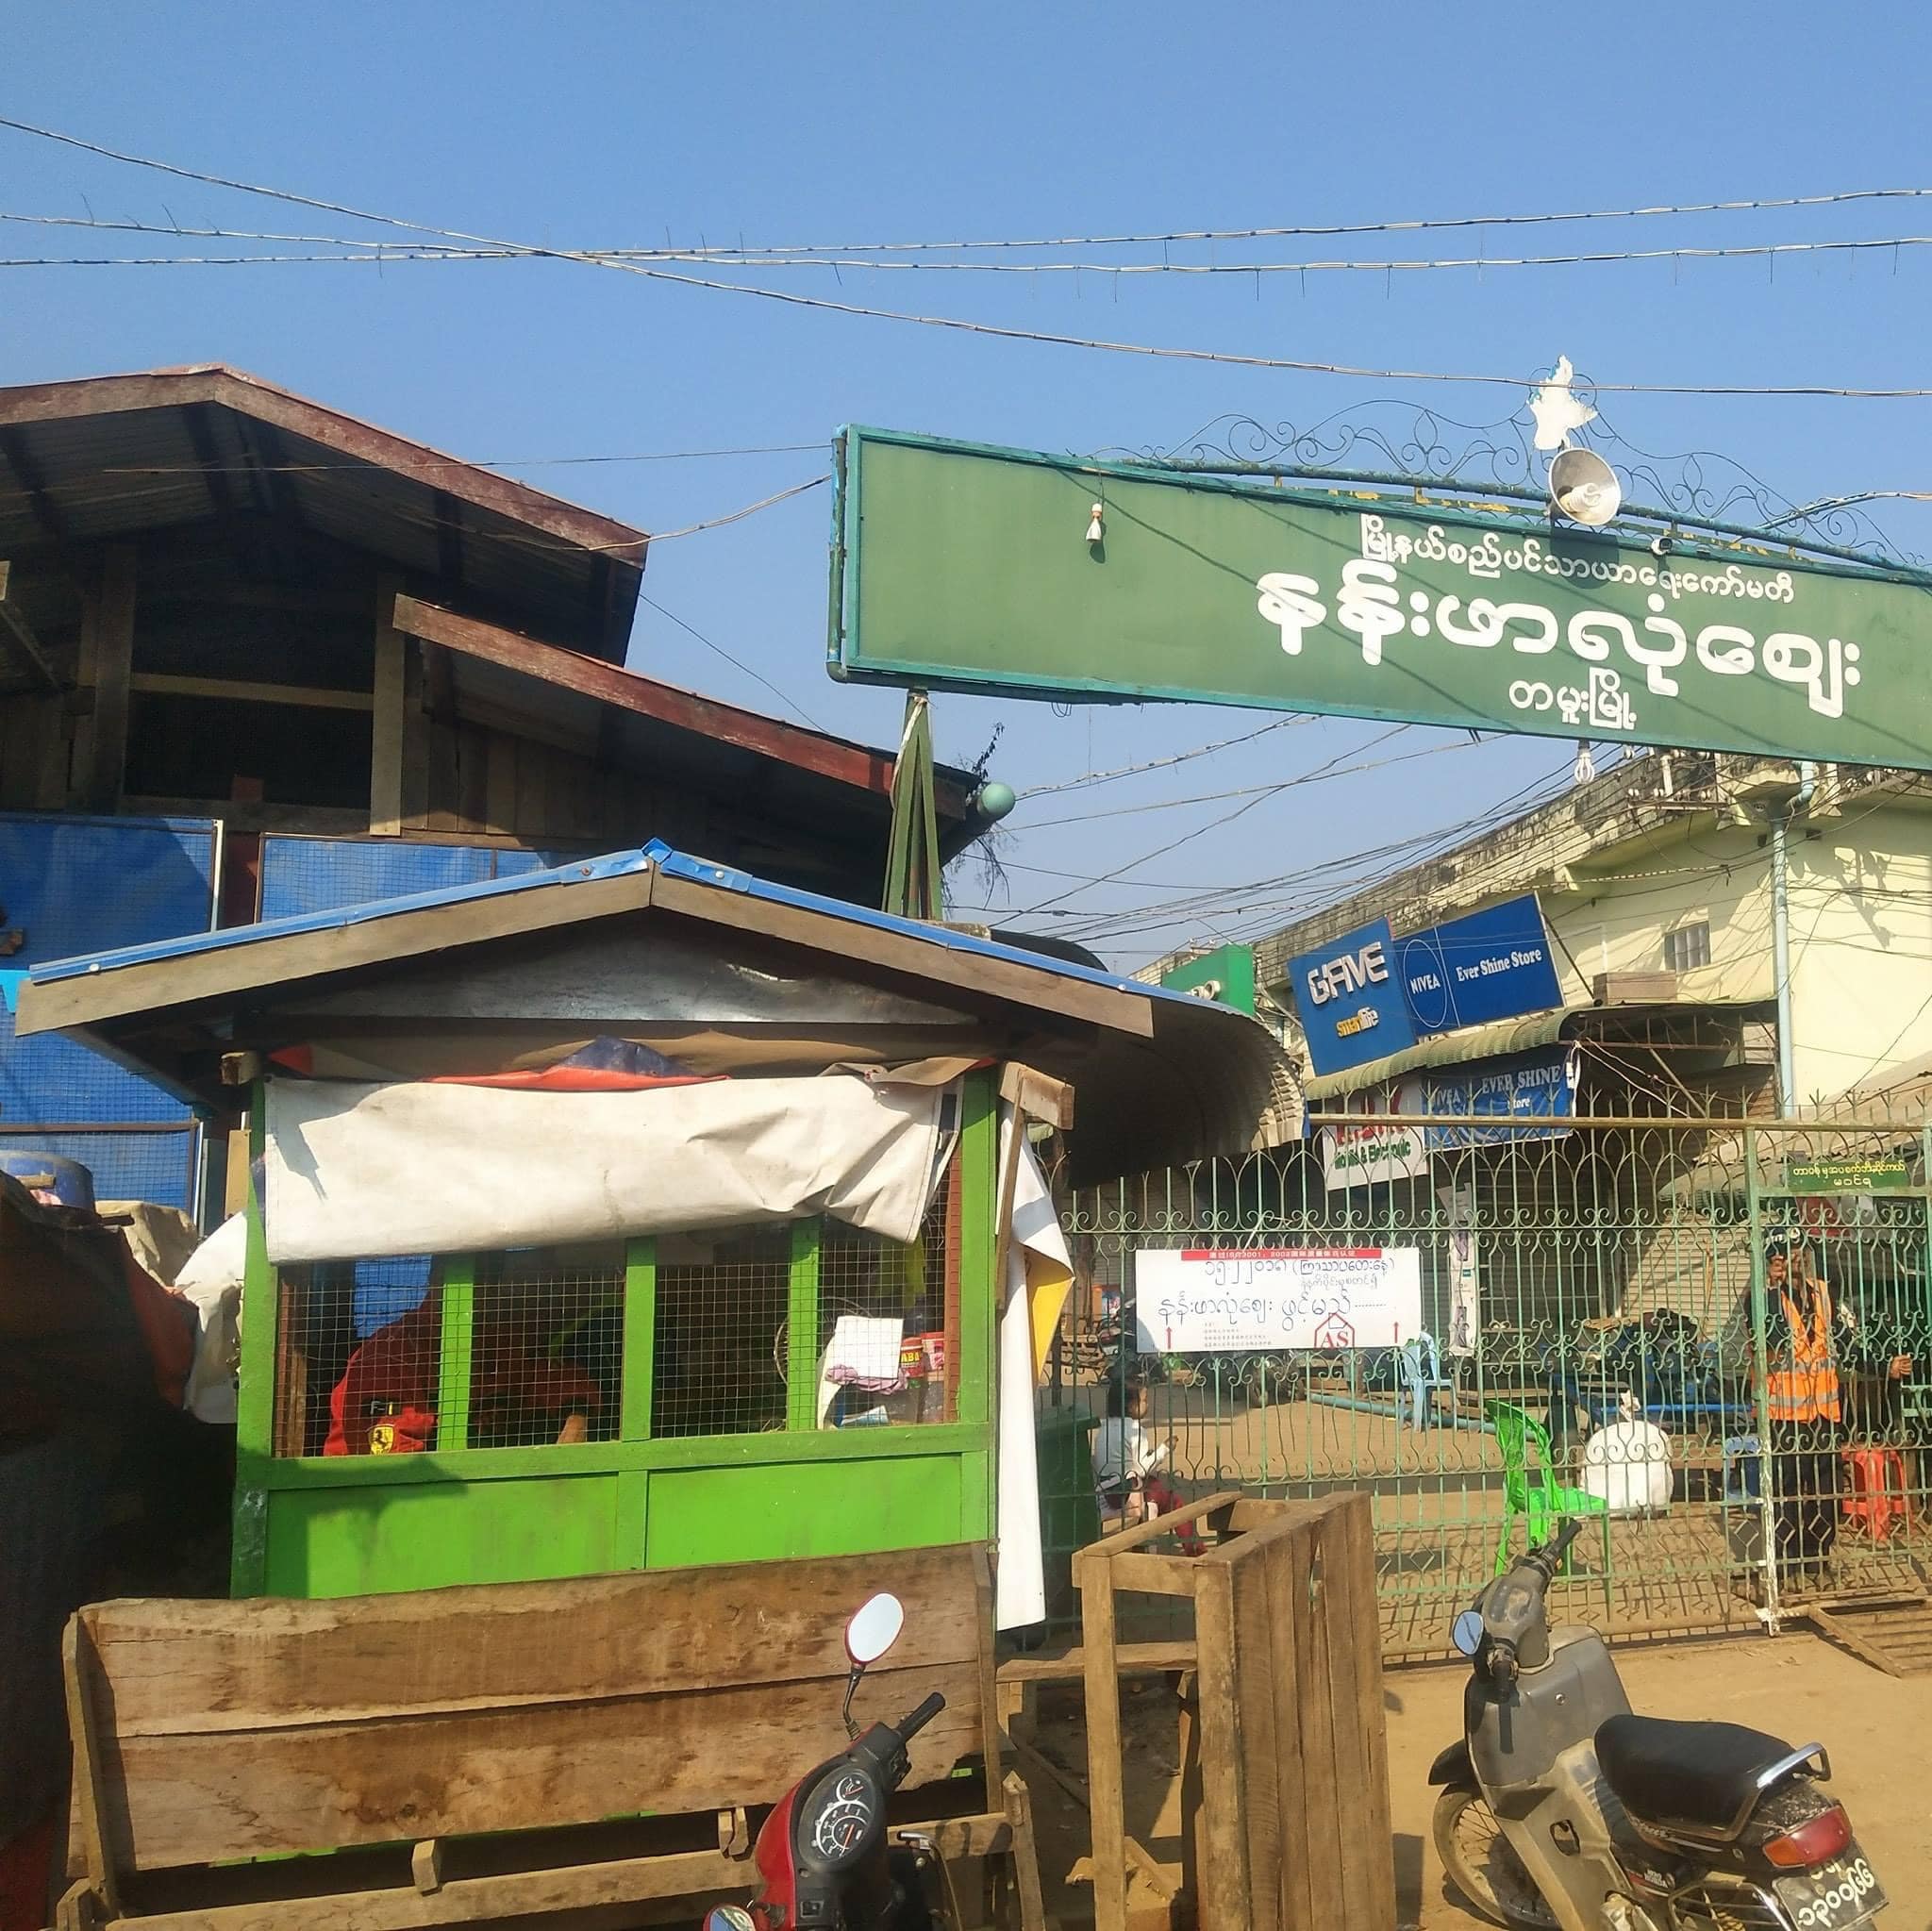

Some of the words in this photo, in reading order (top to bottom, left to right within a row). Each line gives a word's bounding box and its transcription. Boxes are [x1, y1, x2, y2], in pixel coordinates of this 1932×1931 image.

[1456, 965, 1480, 982] Ever
[1479, 957, 1510, 975] Shine
[1510, 949, 1542, 968] Store
[1410, 974, 1441, 994] NIVEA
[1482, 1074, 1514, 1094] EVER
[1517, 1065, 1561, 1089] SHINE
[1321, 1331, 1350, 1349] AS
